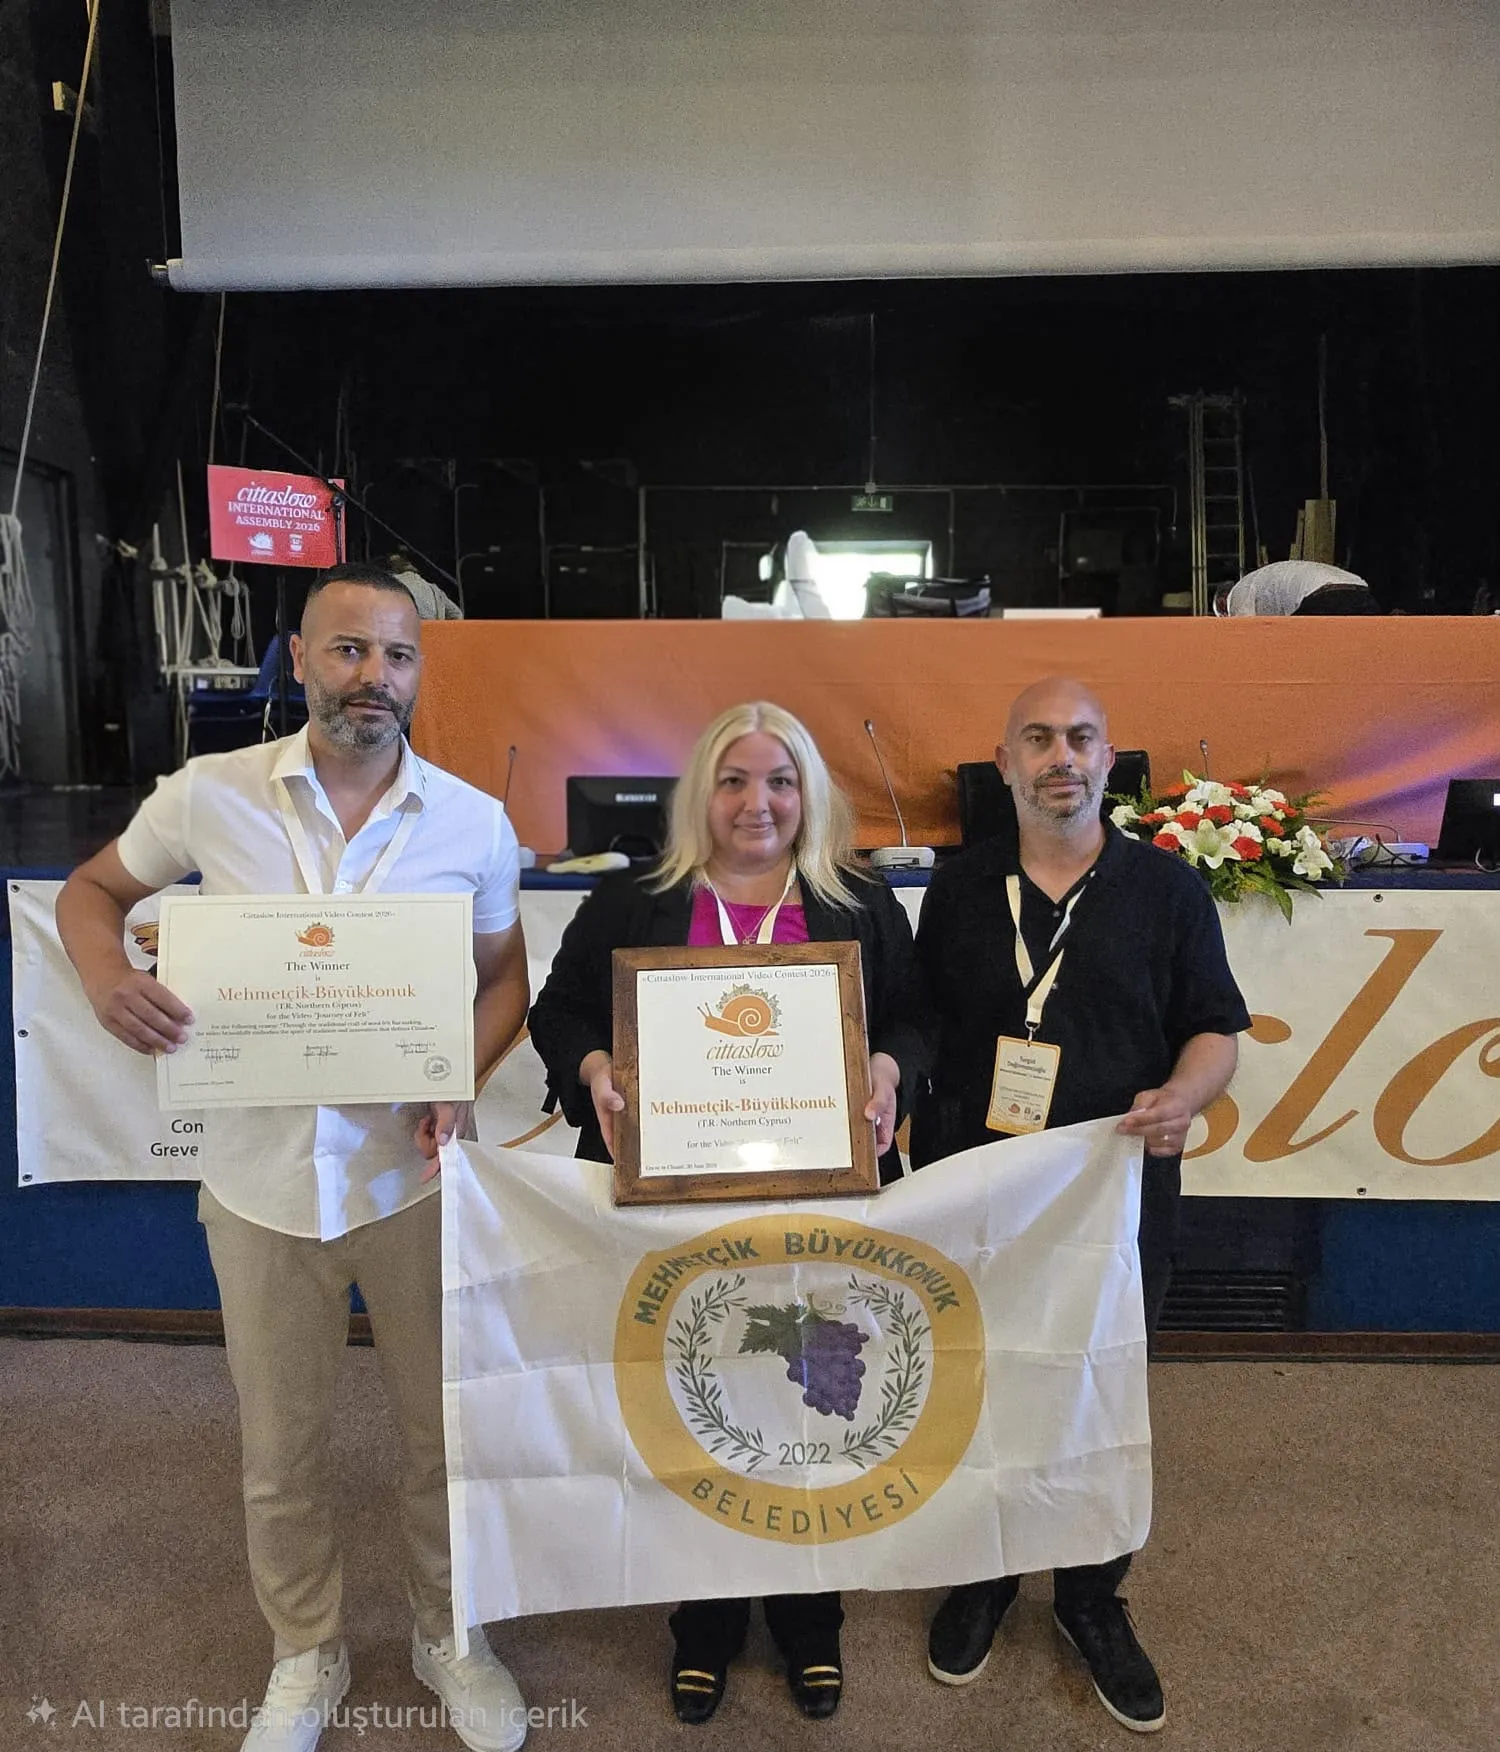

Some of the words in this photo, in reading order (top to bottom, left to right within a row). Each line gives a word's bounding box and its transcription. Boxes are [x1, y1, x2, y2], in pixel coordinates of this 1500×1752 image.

[237, 481, 317, 509] cittaslow
[228, 501, 326, 521] INTERNATIONAL
[236, 515, 292, 529] ASSEMBLY
[294, 522, 321, 532] 2026
[285, 961, 308, 971] The
[309, 961, 350, 970] Winner
[690, 973, 745, 981] International
[774, 970, 807, 979] Contest
[217, 984, 417, 1001] Mehmetçik-Büyükkonuk
[706, 1038, 784, 1060] cittaslow
[712, 1066, 732, 1076] The
[734, 1065, 772, 1075] Winner
[650, 1095, 837, 1116] Mehmetçik-Büyükkonuk
[720, 1118, 757, 1127] Northern
[758, 1117, 791, 1126] Cyprus)
[150, 1142, 199, 1157] Greve
[687, 1141, 698, 1149] for
[700, 1140, 712, 1148] the
[633, 1237, 760, 1325] MEHMETÇİK
[784, 1229, 960, 1313] BÜYÜKKONUK
[778, 1443, 832, 1465] 2022
[692, 1468, 919, 1534] BELEDİYESİ
